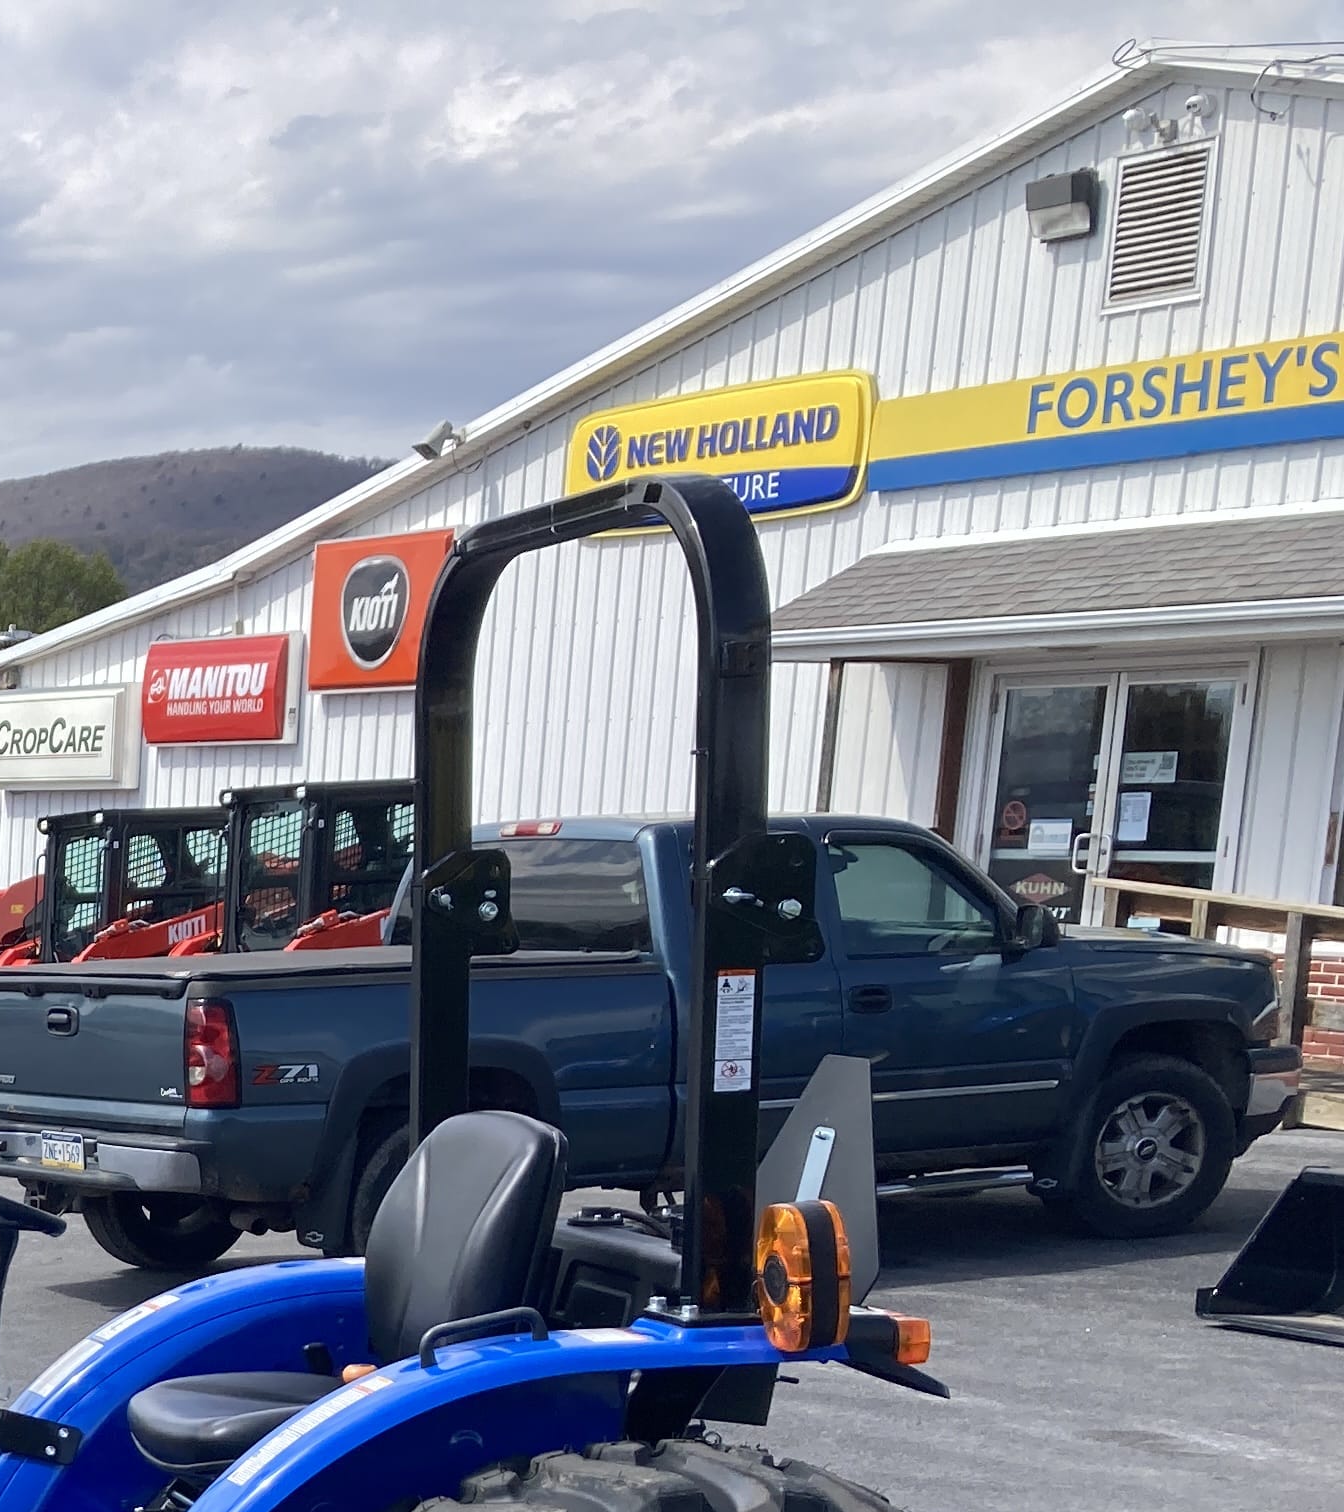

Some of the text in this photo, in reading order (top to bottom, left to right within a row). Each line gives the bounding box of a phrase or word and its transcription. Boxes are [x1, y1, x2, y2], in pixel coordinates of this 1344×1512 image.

[1026, 341, 1340, 434] FORSHEY'S
[626, 403, 840, 469] NEW HOLLAND
[349, 593, 399, 631] KIOTI
[167, 662, 269, 700] MANITOU
[166, 698, 264, 717] HANDLING YOUR WORLD
[1015, 880, 1065, 896] KUHN
[167, 914, 207, 945] KIOTI
[250, 1063, 319, 1085] Z71
